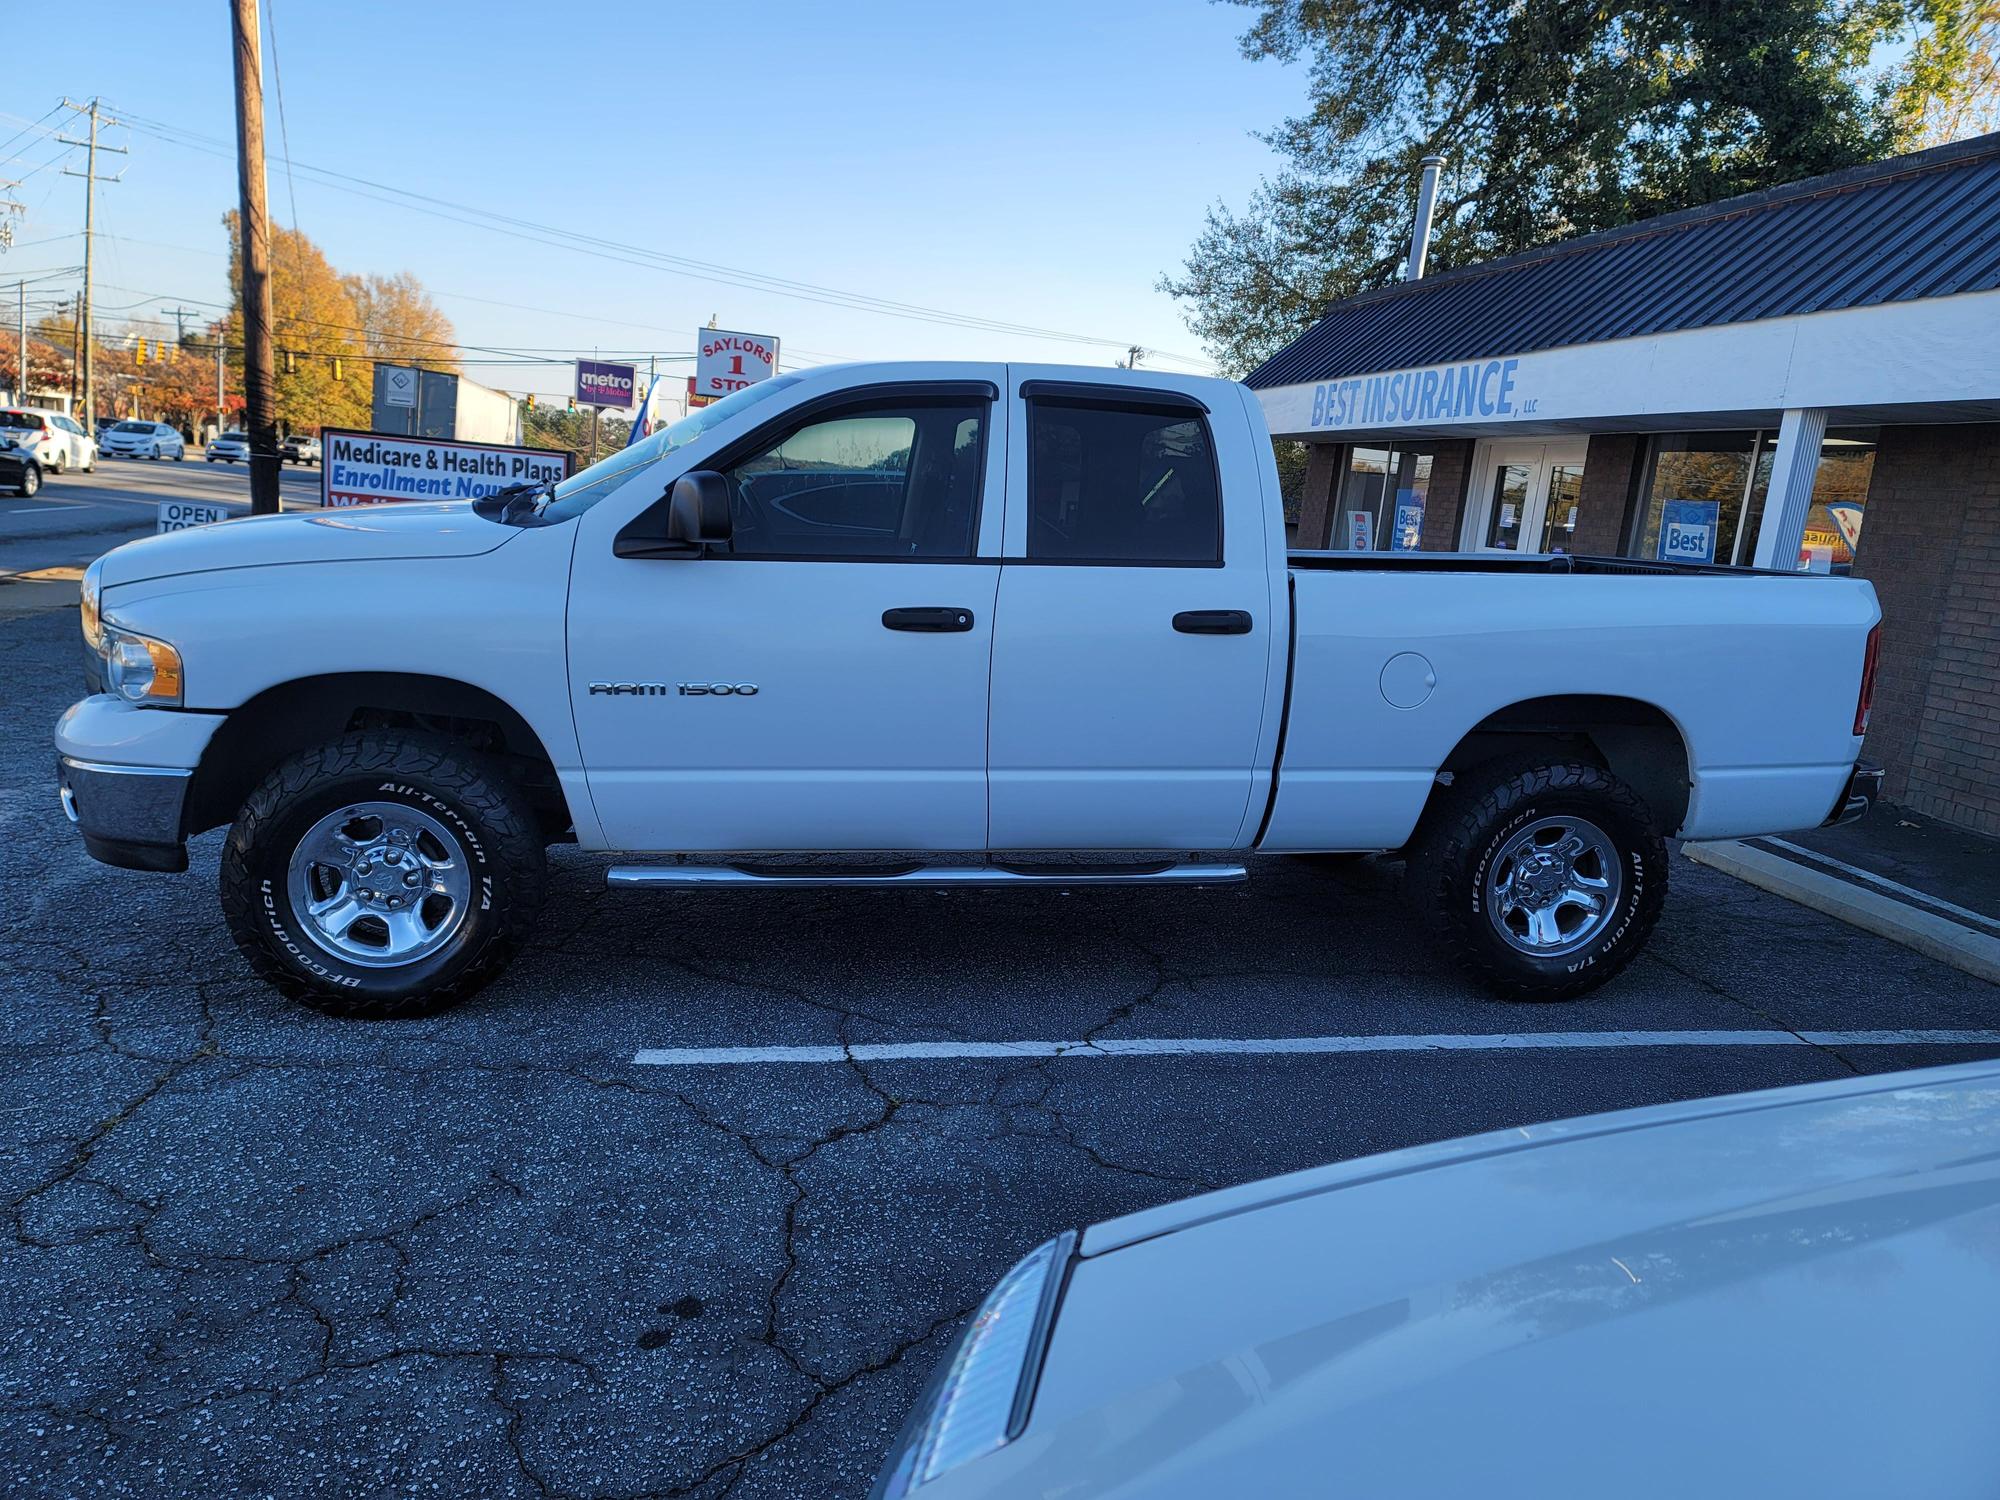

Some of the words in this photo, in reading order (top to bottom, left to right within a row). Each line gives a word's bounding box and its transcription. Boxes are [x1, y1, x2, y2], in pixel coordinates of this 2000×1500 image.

[702, 338, 773, 364] SAYLORS
[727, 355, 746, 375] 1
[581, 372, 632, 389] metro
[710, 377, 758, 391] STO
[1311, 379, 1362, 427] BEST
[1523, 399, 1539, 414] LLC
[333, 439, 421, 469] Medicare
[426, 450, 438, 470] &
[443, 450, 506, 477] Health
[512, 457, 562, 482] Plans
[332, 464, 450, 496] Enrollment
[168, 505, 218, 523] OPEN
[1668, 528, 1705, 553] Best
[588, 681, 667, 697] RAM
[676, 681, 760, 697] 1500
[378, 781, 488, 864] All-Terrain
[480, 874, 493, 911] T/A
[1472, 807, 1537, 913] BFGoodrich
[1602, 851, 1644, 953] All-Terrain
[260, 878, 361, 989] BFGoodrich
